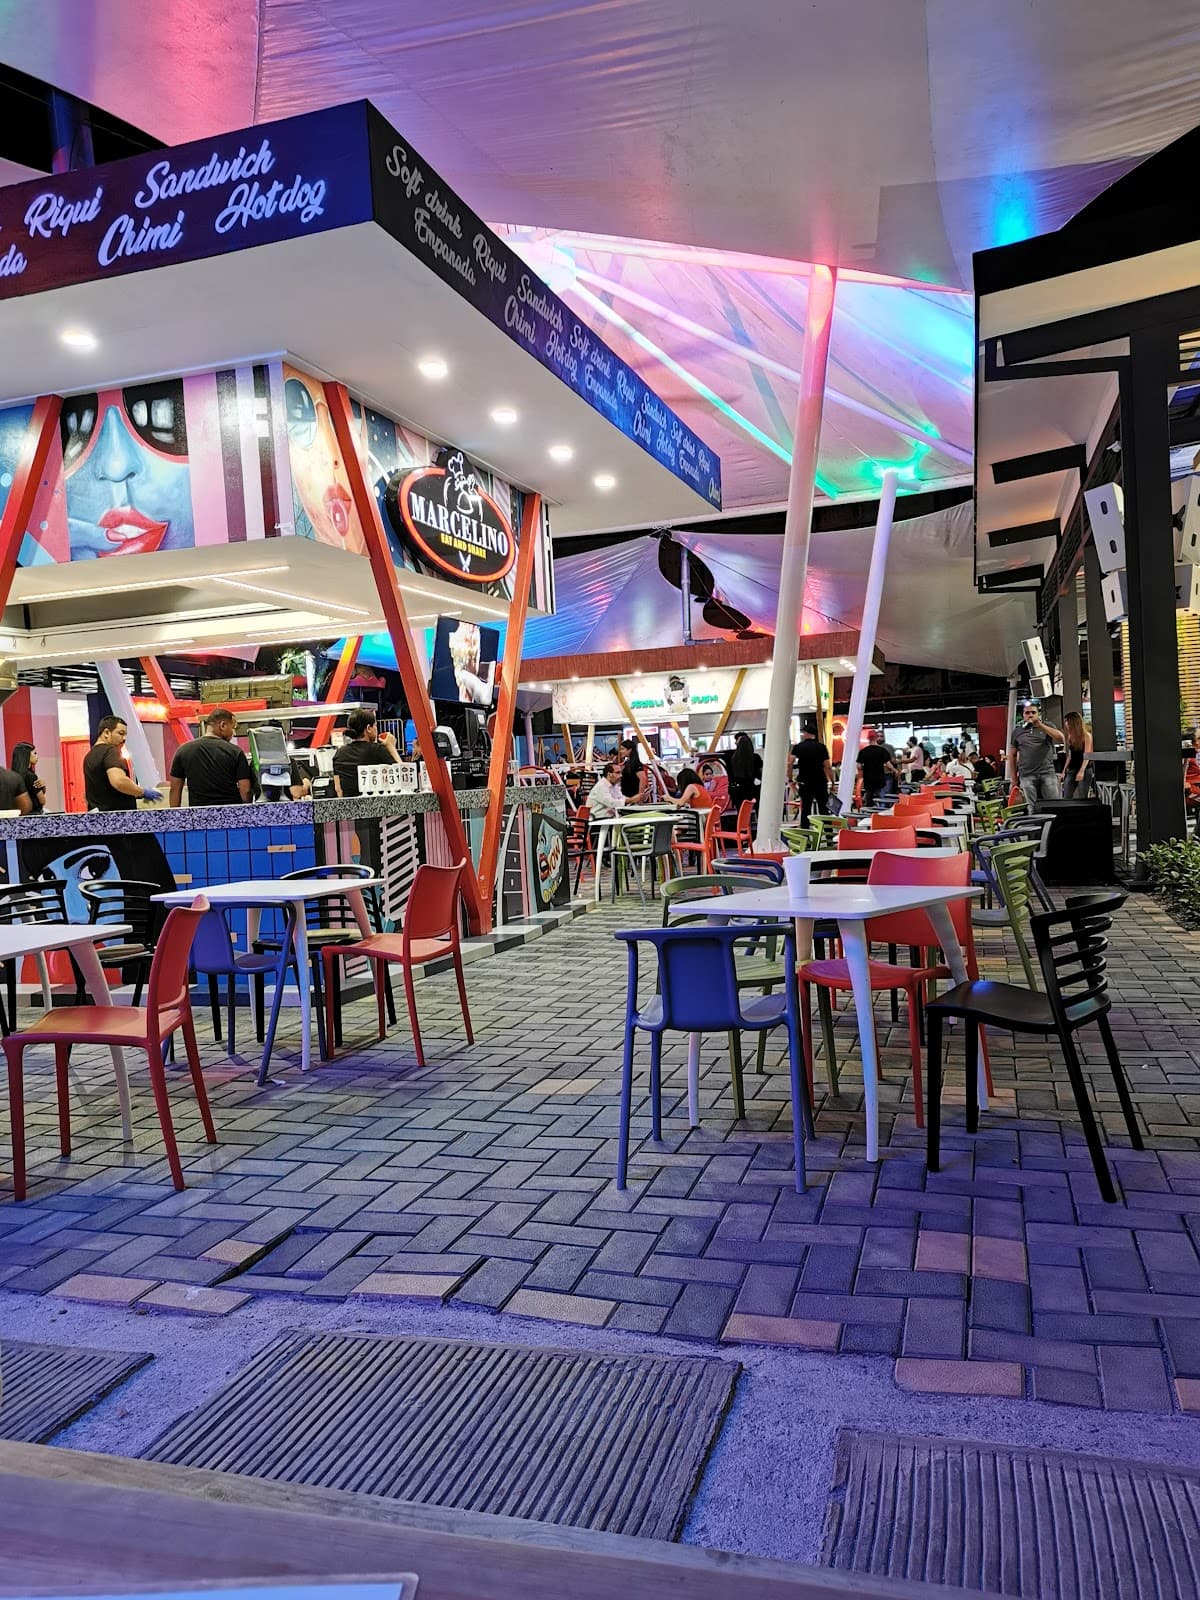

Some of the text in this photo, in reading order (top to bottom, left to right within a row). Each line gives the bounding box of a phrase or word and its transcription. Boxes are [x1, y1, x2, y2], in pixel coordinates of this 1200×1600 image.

[24, 139, 275, 238] Riqui Sandwich
[98, 211, 185, 267] Chimi
[385, 145, 424, 199] Soft
[424, 190, 463, 240] drink
[472, 233, 507, 284] Riqui
[517, 274, 563, 333] Sandwich
[570, 324, 591, 361] Soft
[414, 206, 477, 286] Empanada
[504, 295, 536, 345] Chimi
[409, 491, 509, 557] MARCELINO
[453, 537, 467, 551] AND
[361, 776, 367, 786] 7
[372, 775, 378, 786] 6
[389, 775, 395, 785] 3
